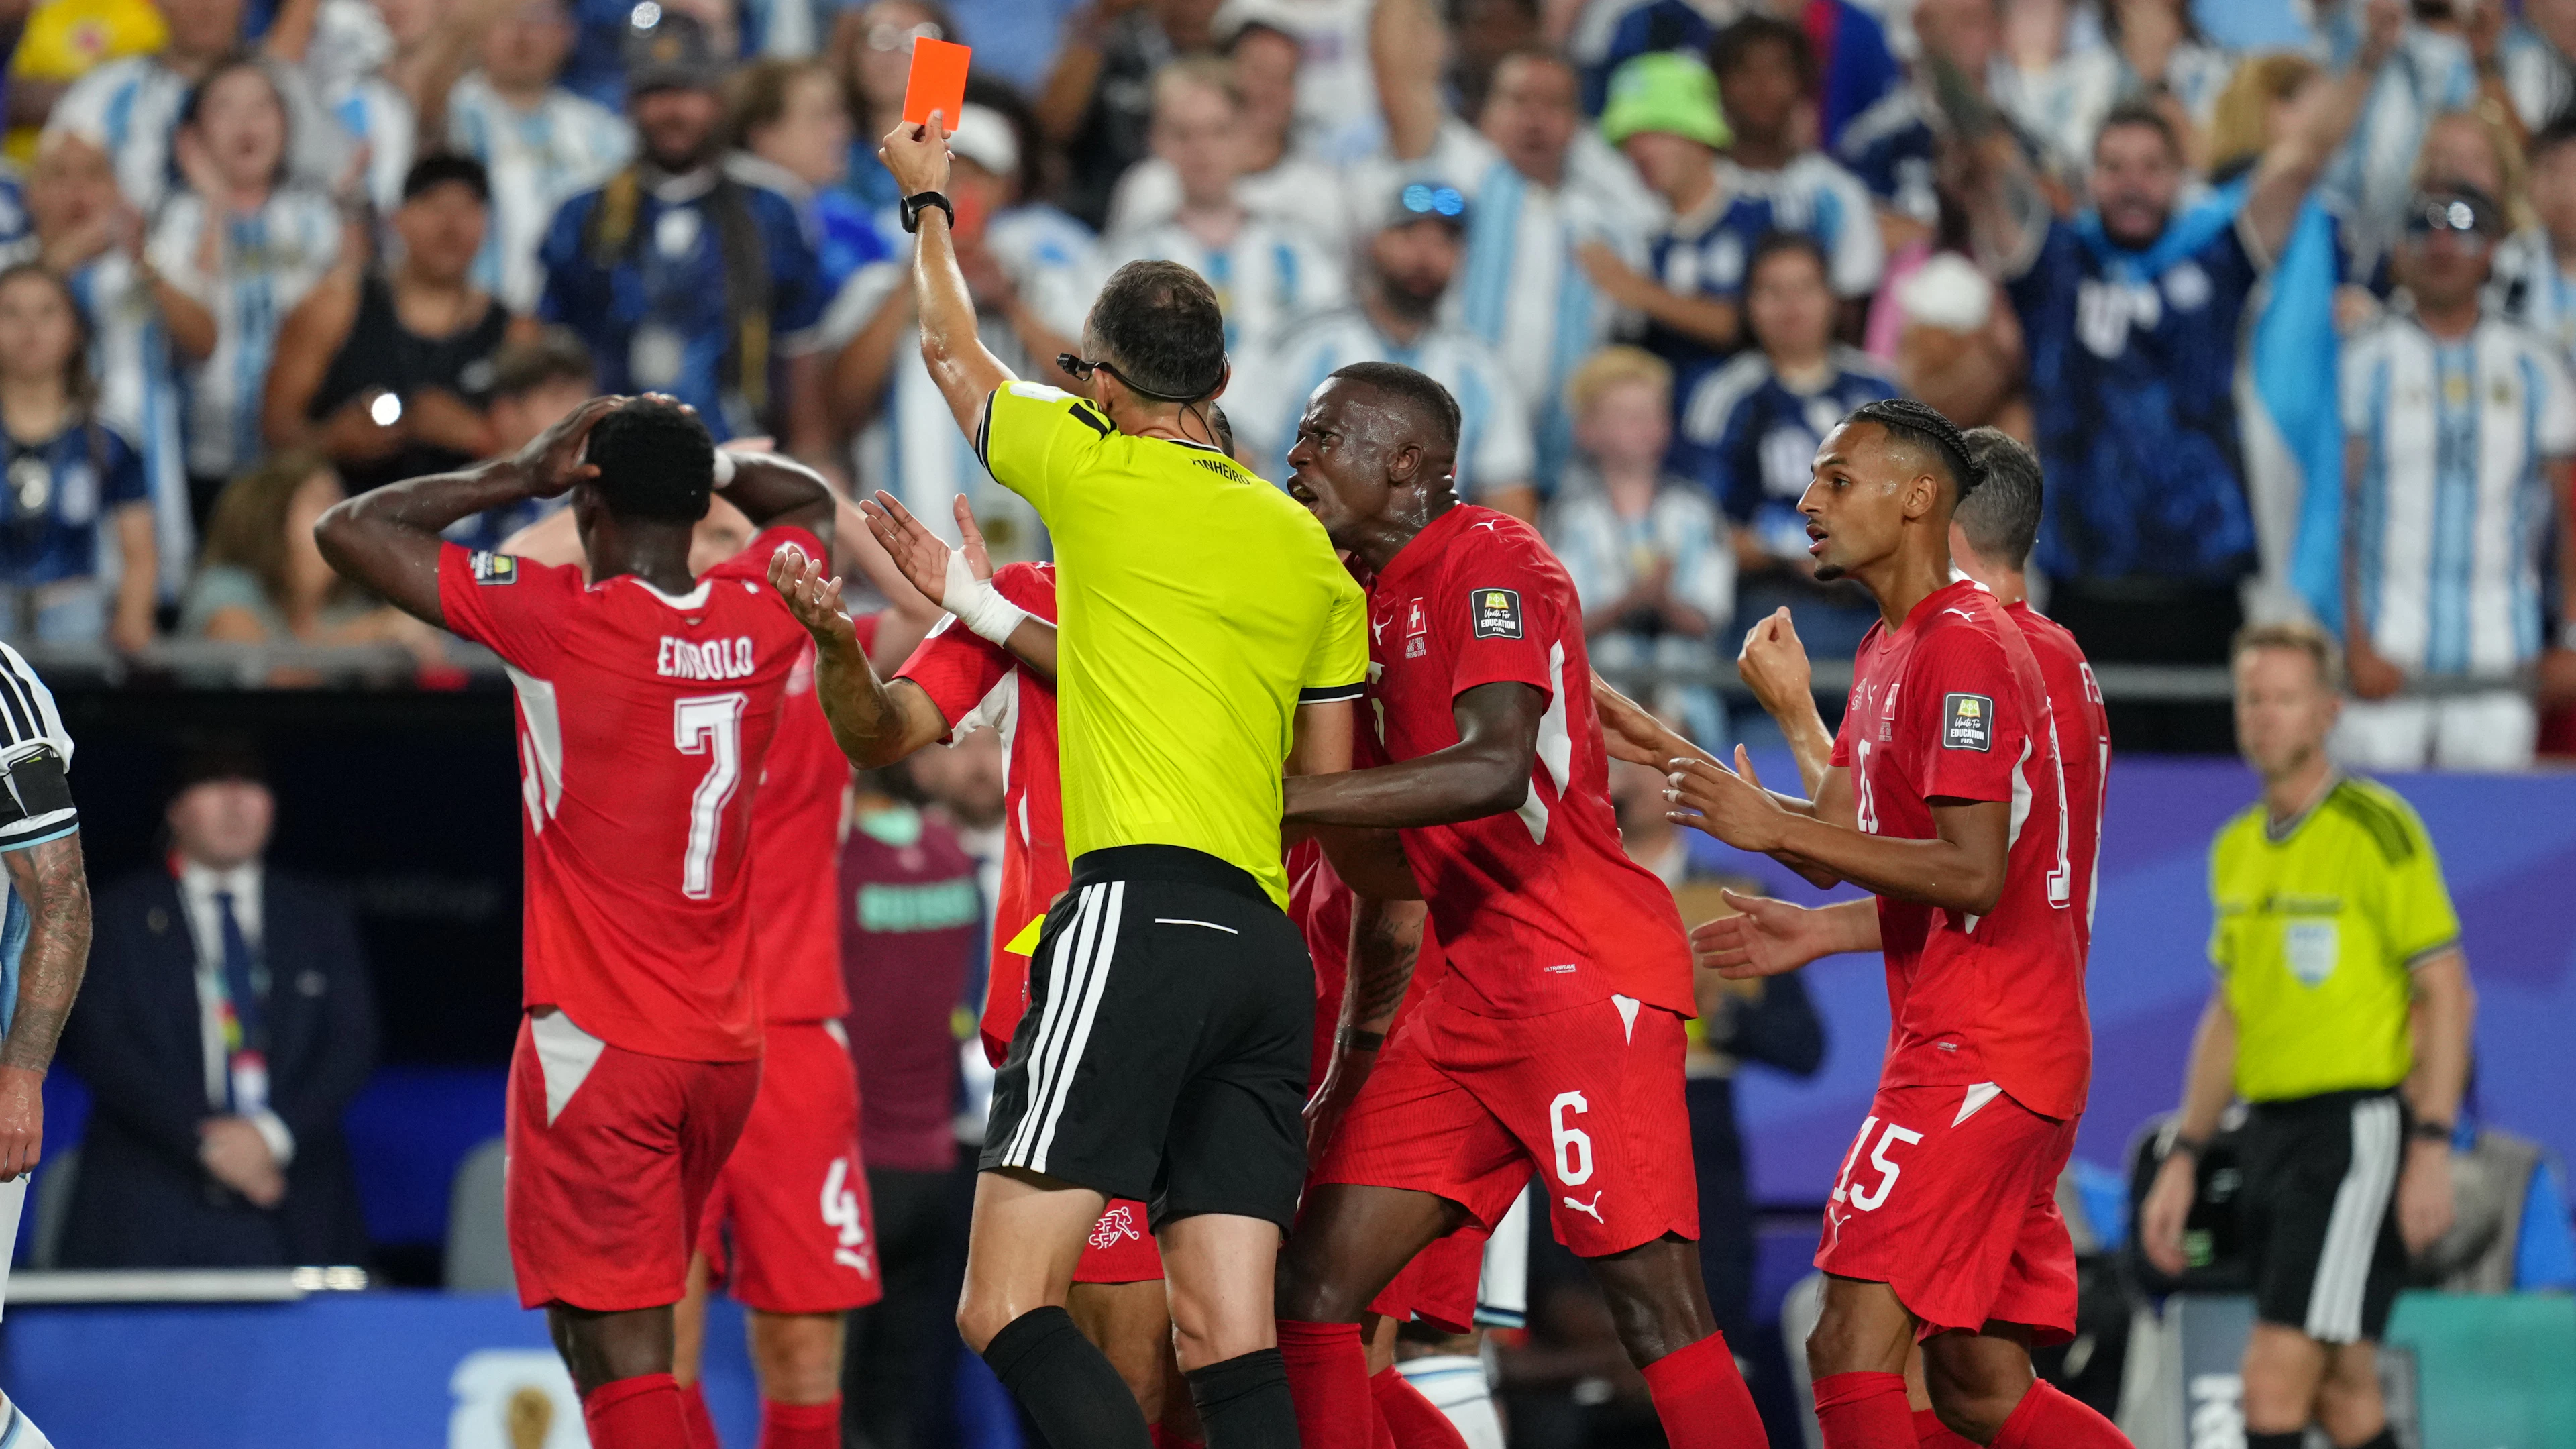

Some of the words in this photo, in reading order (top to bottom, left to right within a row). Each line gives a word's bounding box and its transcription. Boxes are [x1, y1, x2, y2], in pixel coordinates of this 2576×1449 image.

[1481, 619, 1515, 629] EDUCATION
[1484, 608, 1501, 619] Unite
[1501, 610, 1511, 619] For
[1950, 728, 1984, 741] EDUCATION
[1955, 716, 1972, 728] Unite
[1972, 719, 1981, 729] For
[674, 692, 749, 900] 7
[1550, 1091, 1593, 1187] 6
[1832, 1116, 1925, 1212] 15
[820, 1156, 866, 1248] 4
